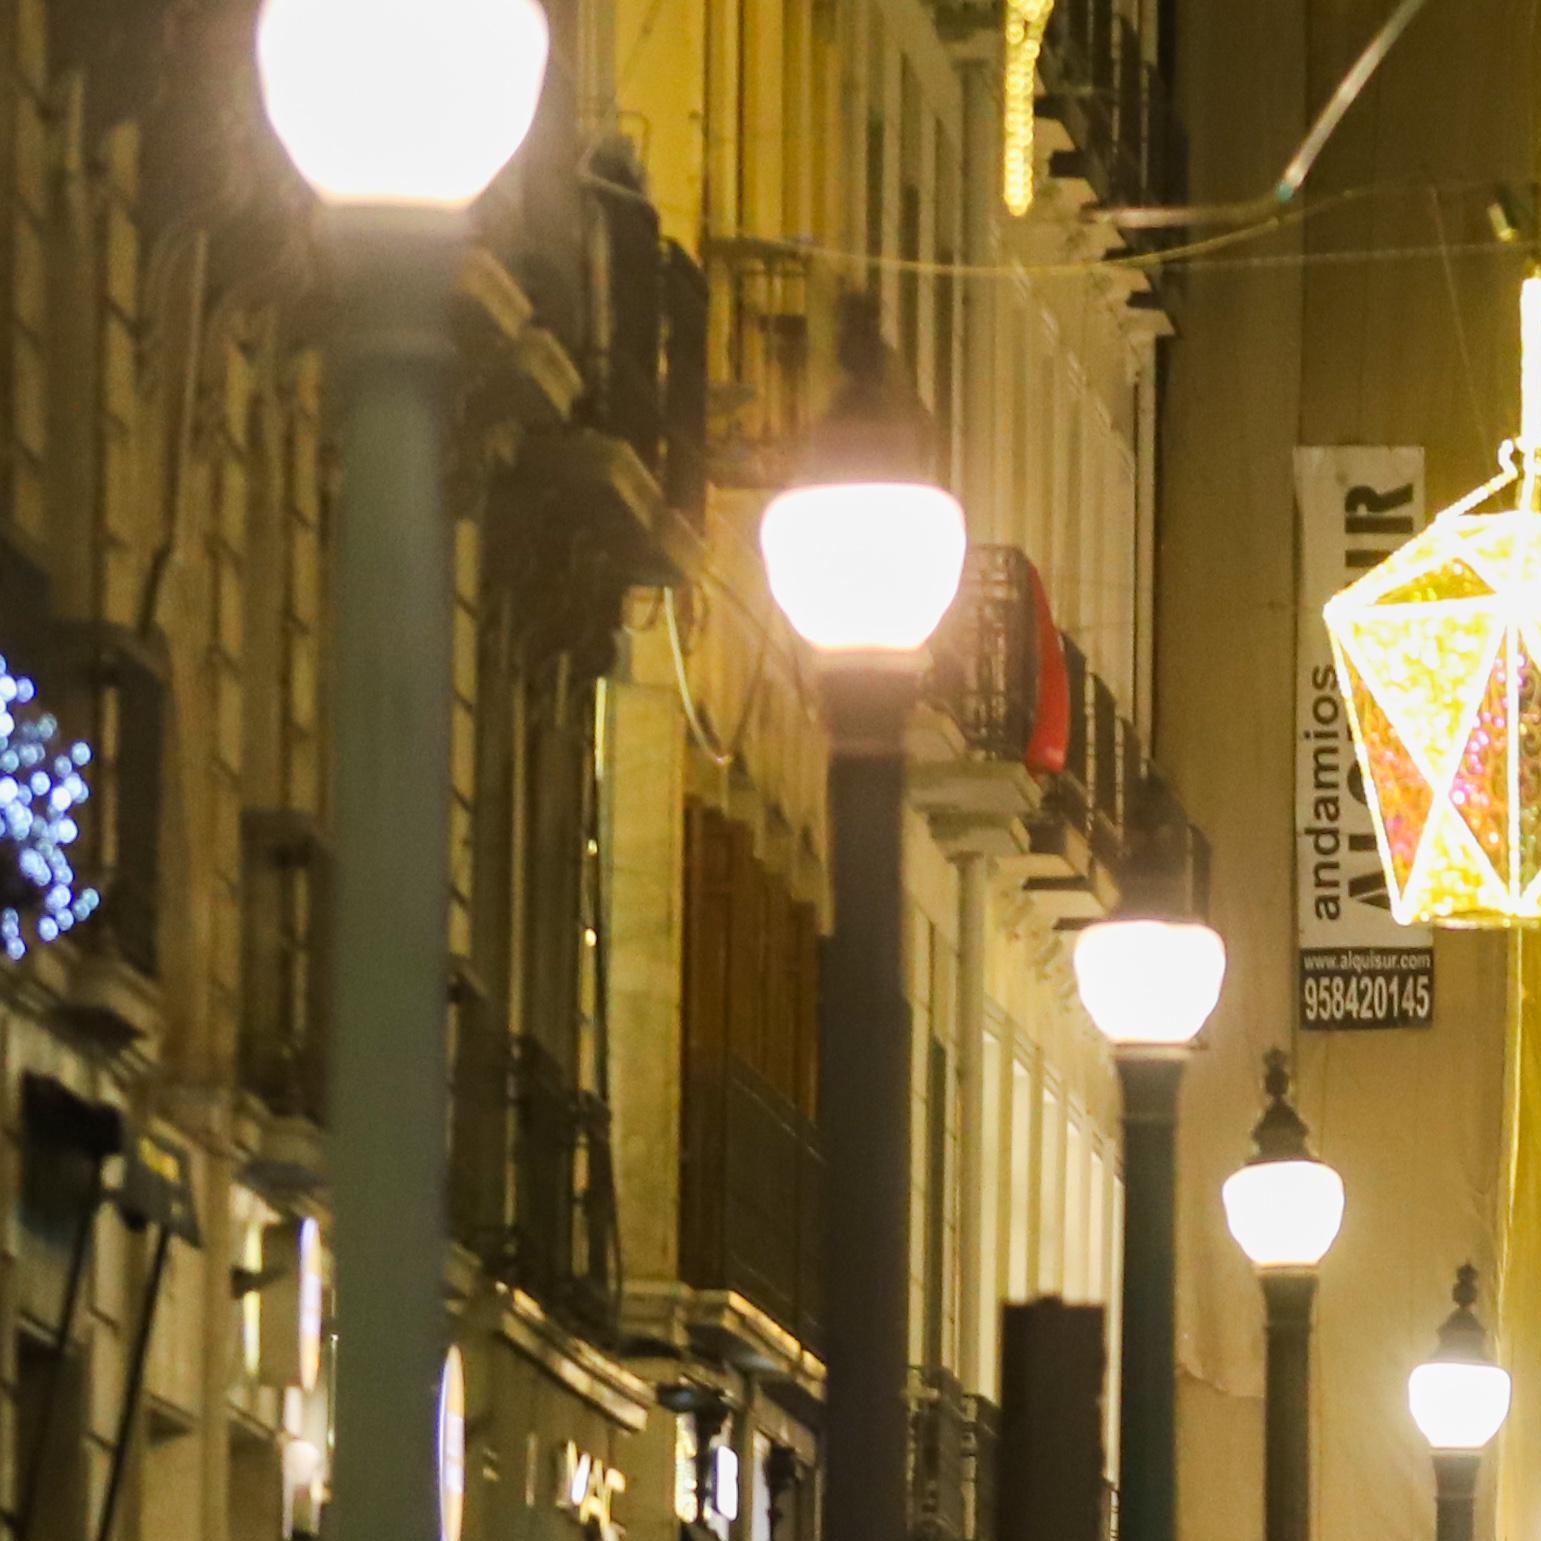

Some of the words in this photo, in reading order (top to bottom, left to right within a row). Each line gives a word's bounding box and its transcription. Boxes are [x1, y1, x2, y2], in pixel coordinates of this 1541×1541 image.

[1303, 662, 1340, 921] andamios
[1304, 951, 1431, 973] www.alquisur.com
[1304, 975, 1430, 1020] 958420145
